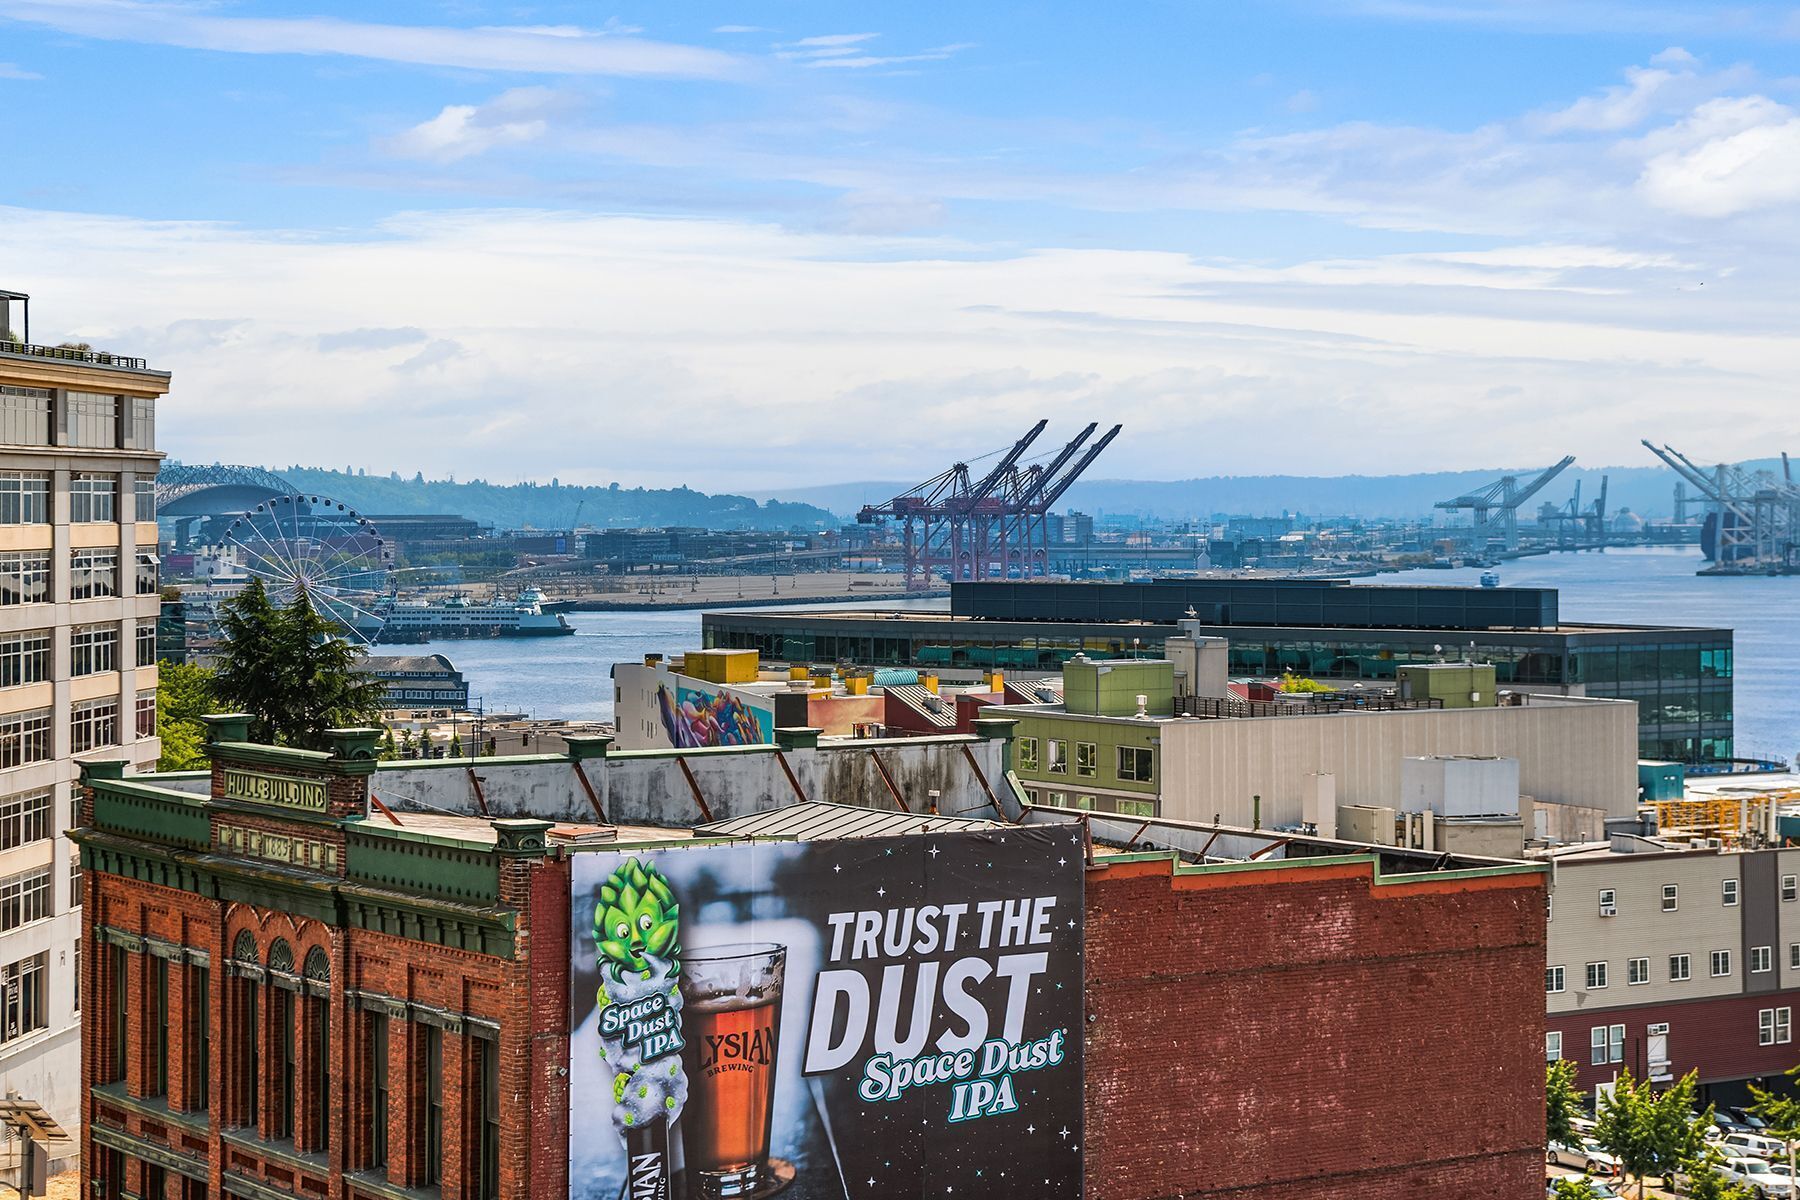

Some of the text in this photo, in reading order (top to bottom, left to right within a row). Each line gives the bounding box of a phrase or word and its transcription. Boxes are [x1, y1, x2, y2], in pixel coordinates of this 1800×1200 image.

[228, 773, 324, 807] HULL BUILDING
[265, 836, 289, 858] 1889
[828, 896, 1057, 962] TRUST THE
[602, 996, 663, 1032] Space
[627, 1009, 674, 1042] Dust
[805, 951, 1049, 1074] DUST
[643, 1027, 683, 1060] IPA
[706, 1062, 755, 1079] BREWING
[859, 1030, 1063, 1100] Space Dust
[949, 1074, 1018, 1121] IPA
